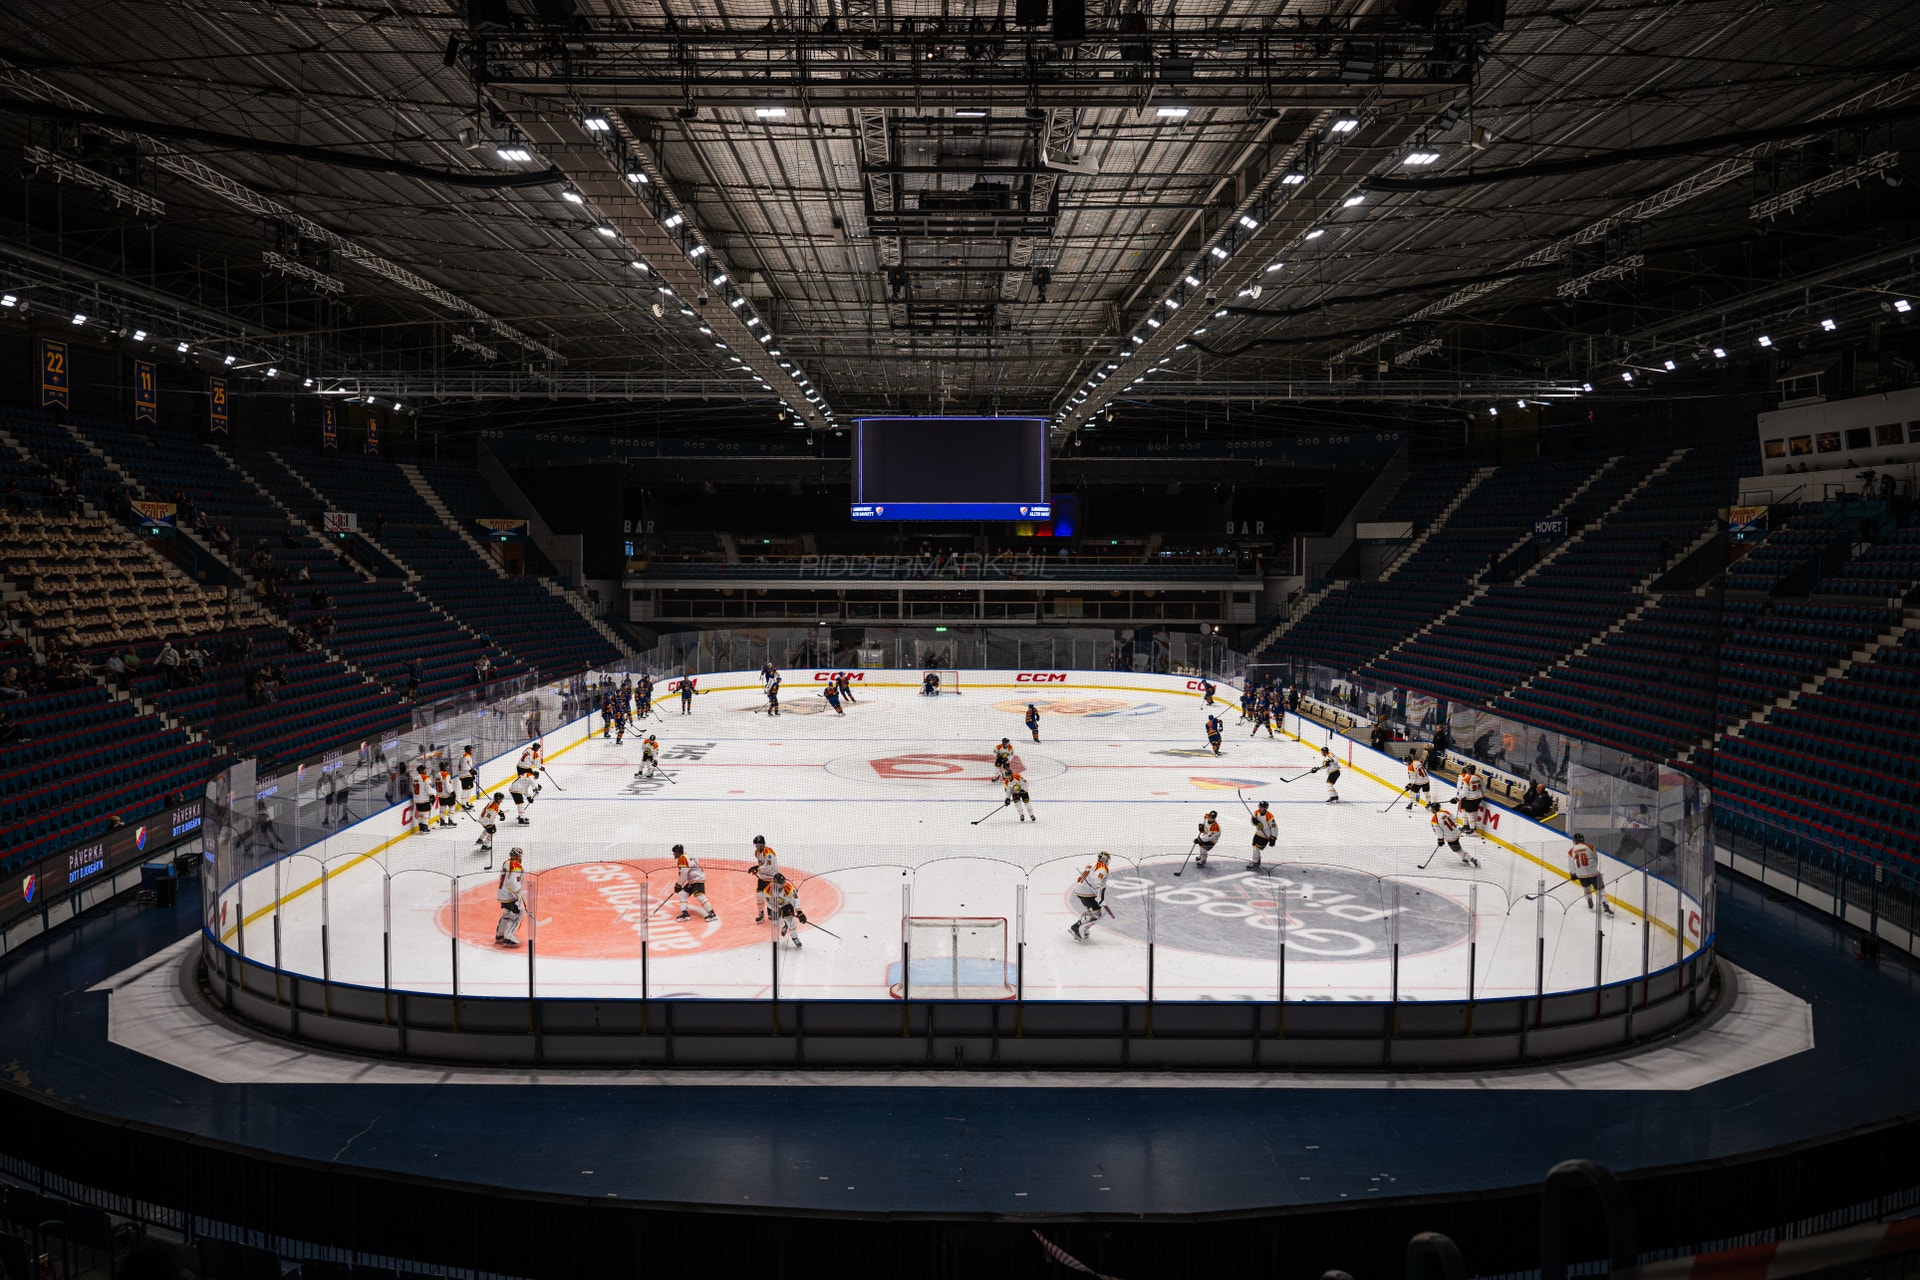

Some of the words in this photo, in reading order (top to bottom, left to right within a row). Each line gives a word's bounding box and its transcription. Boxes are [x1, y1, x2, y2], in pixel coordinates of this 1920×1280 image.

[47, 351, 64, 375] 22
[140, 371, 151, 391] 11
[213, 386, 225, 405] 25
[144, 510, 166, 519] GULD
[623, 520, 655, 533] BAR
[1226, 520, 1264, 535] BAR
[1535, 521, 1562, 533] HOVET
[799, 553, 1004, 578] RIDDERMARK
[1011, 553, 1055, 579] BIL
[814, 672, 864, 681] CCM
[1016, 673, 1067, 682] CCM
[1187, 680, 1217, 691] CC
[172, 803, 201, 825] PÅVERKA
[69, 843, 104, 870] PÅVERKA
[1574, 851, 1589, 868] 10
[1202, 871, 1410, 922] Pixel
[1104, 876, 1376, 956] Google
